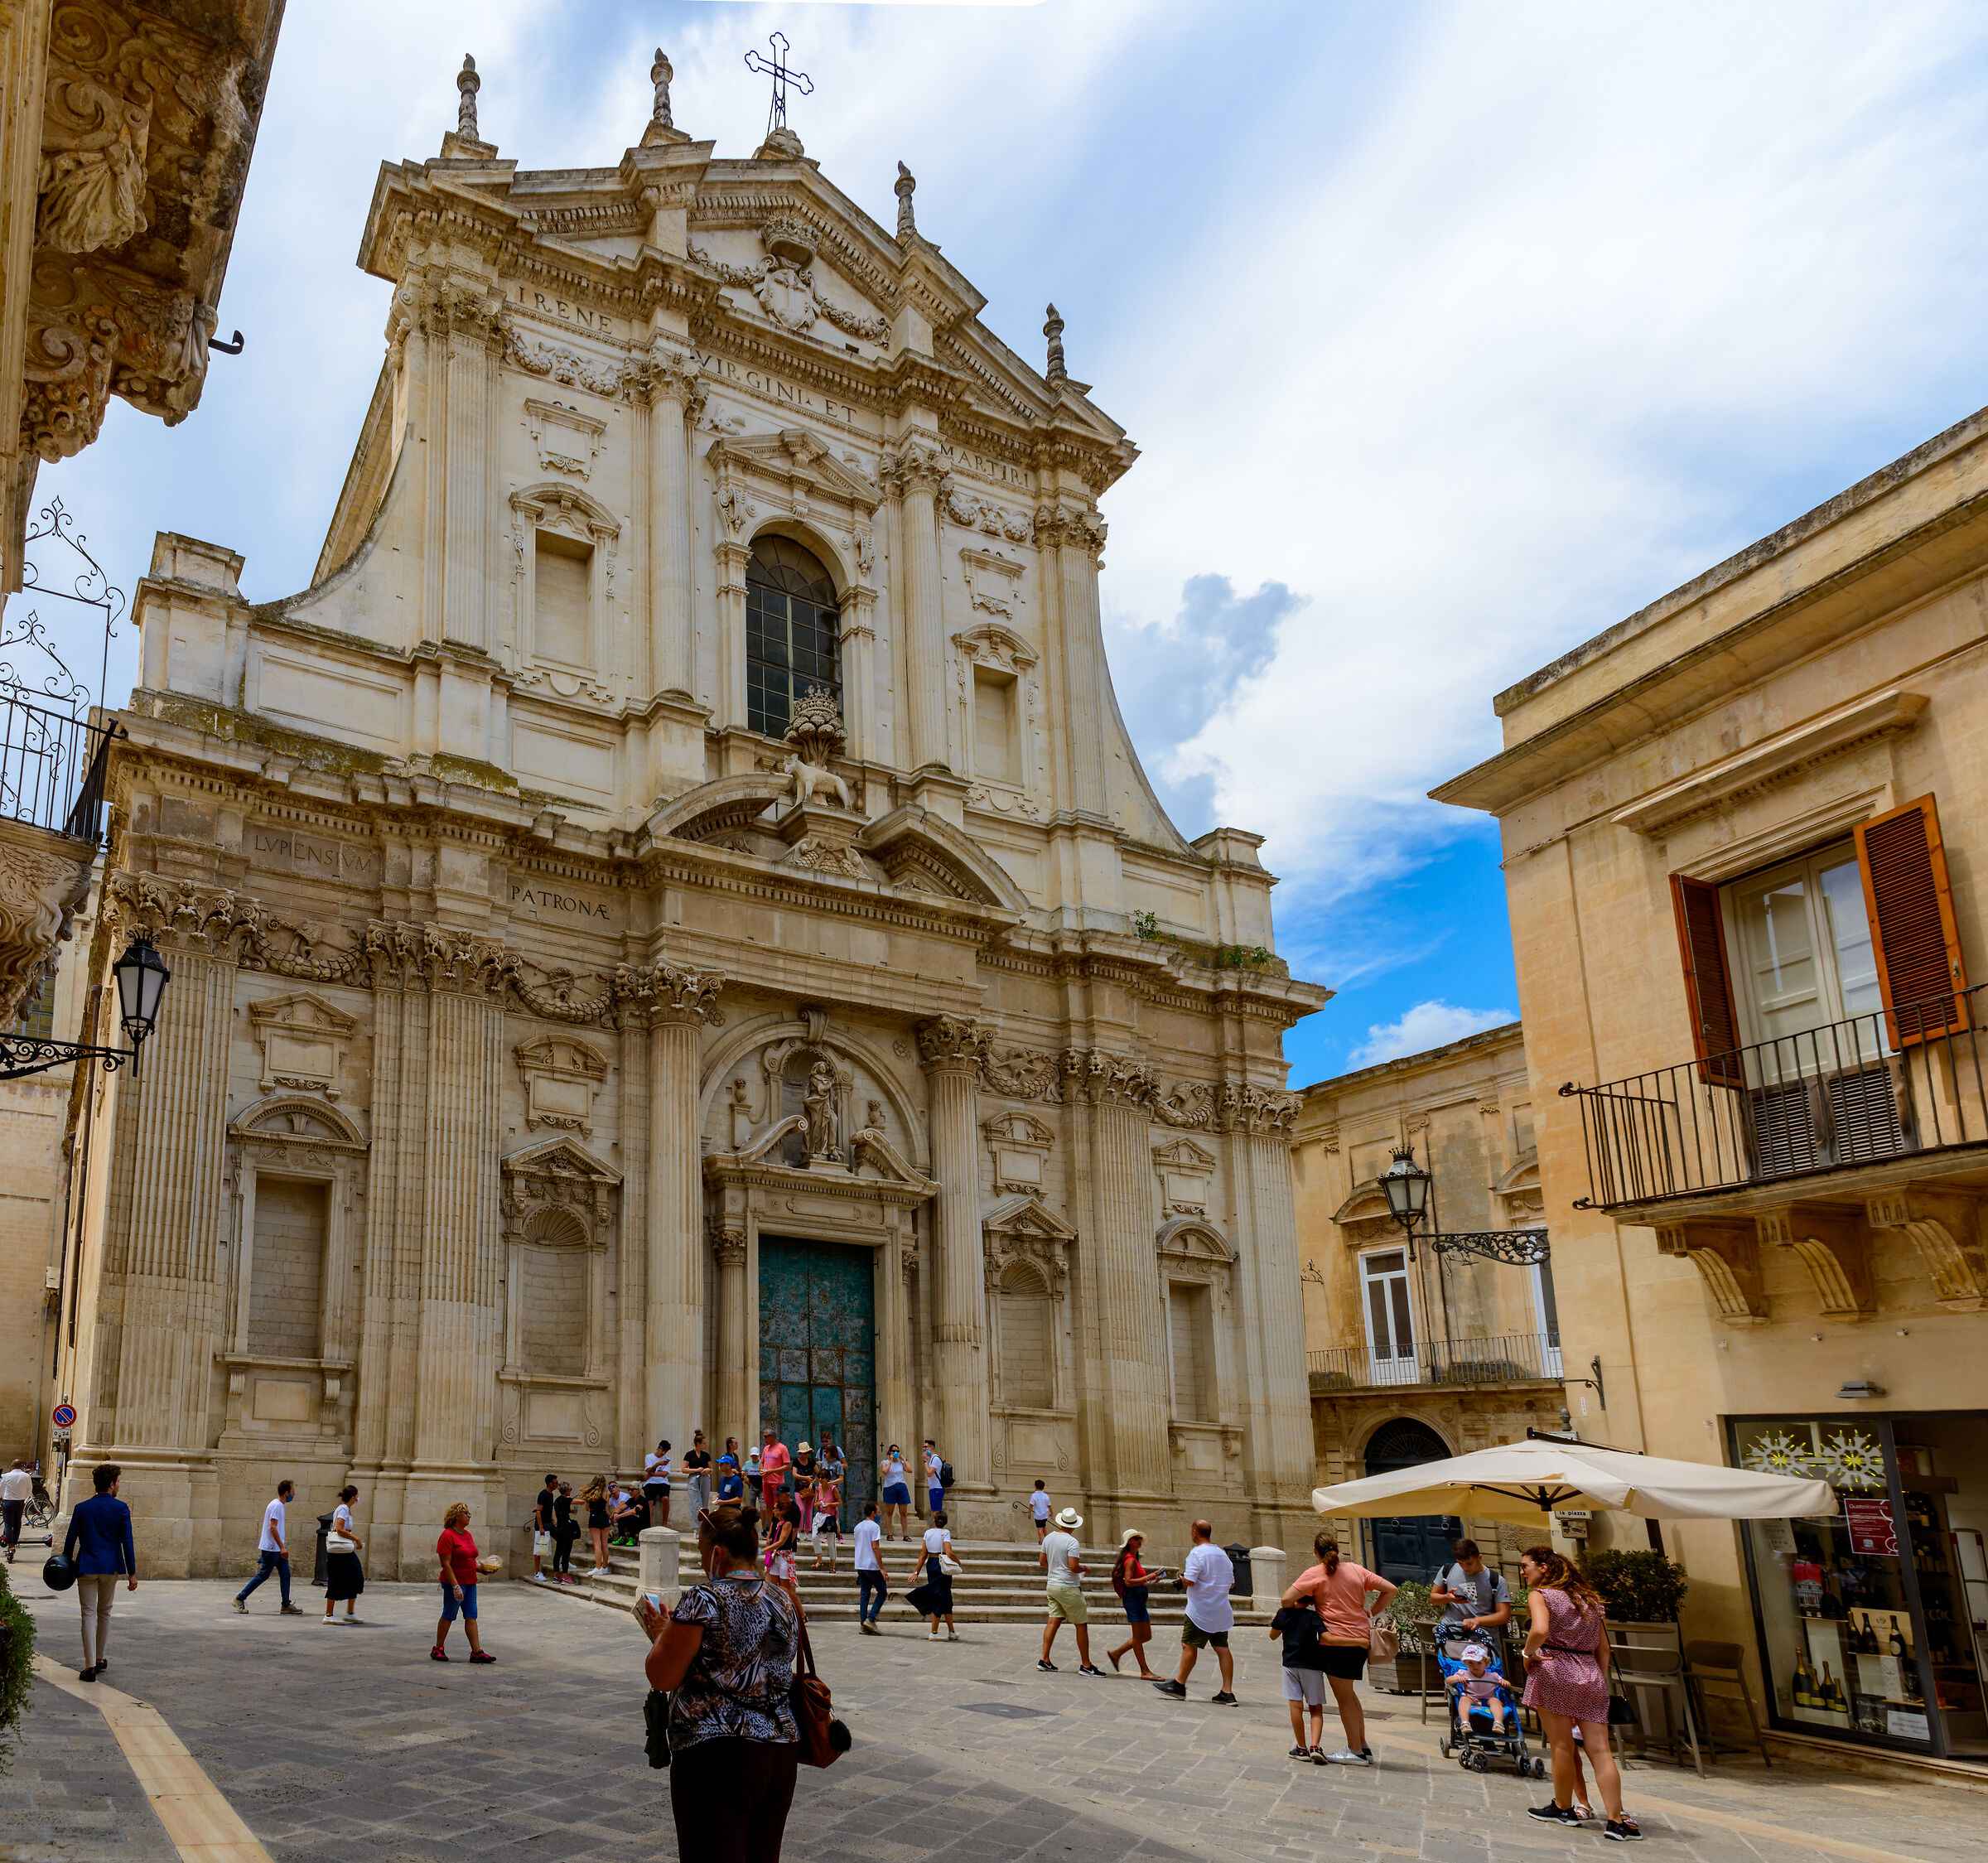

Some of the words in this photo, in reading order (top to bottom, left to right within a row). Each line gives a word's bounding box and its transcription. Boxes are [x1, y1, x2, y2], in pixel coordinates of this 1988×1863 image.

[519, 286, 612, 335] IRENE
[826, 399, 856, 423] ET
[940, 443, 1029, 488] MARTIRI
[511, 885, 610, 920] PATRONÆ
